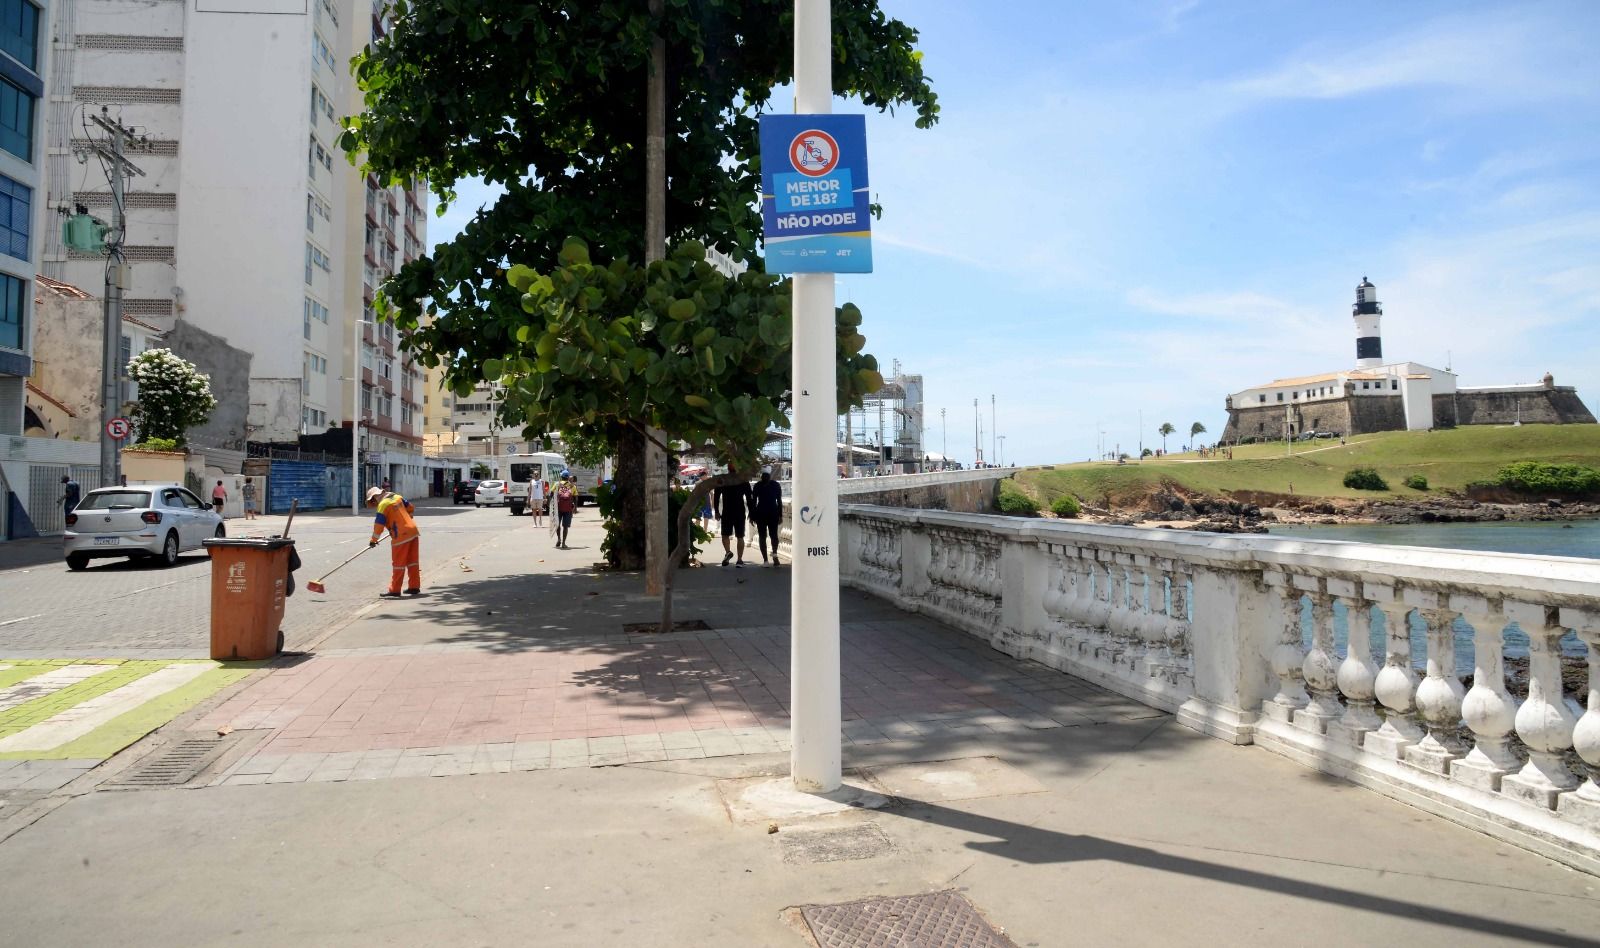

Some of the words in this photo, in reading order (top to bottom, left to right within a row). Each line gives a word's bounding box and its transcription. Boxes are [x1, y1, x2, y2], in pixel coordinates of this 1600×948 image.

[787, 180, 840, 194] MENOR
[791, 195, 810, 207] DE
[813, 192, 838, 205] 18?
[777, 213, 810, 229] NÃO
[812, 212, 856, 227] PODE!
[836, 249, 851, 257] JET
[113, 422, 122, 434] E
